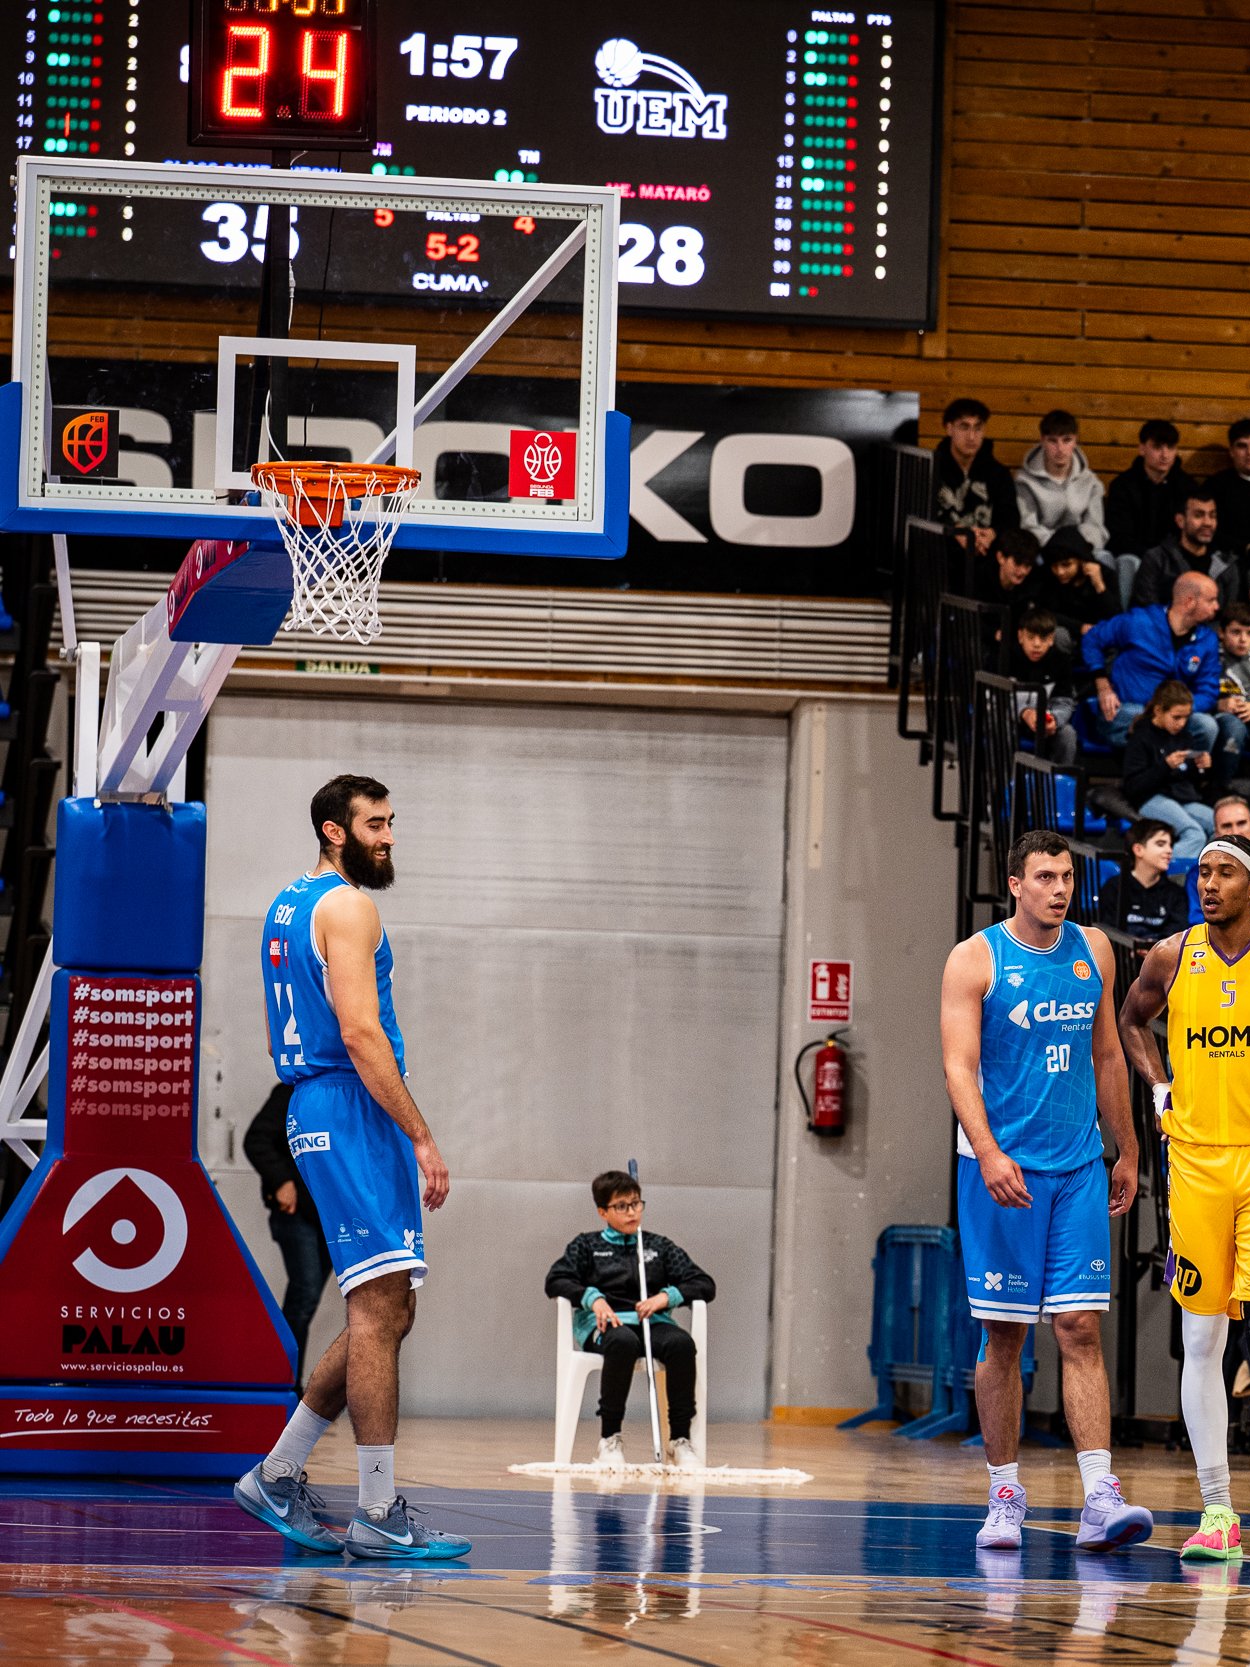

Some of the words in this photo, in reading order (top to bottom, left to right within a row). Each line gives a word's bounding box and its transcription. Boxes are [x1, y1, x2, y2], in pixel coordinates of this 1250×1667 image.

[26, 8, 37, 22] 4
[128, 13, 139, 28] 2
[126, 56, 138, 70] 2
[399, 32, 518, 80] 1:57
[786, 49, 797, 63] 2
[18, 72, 35, 86] 10
[126, 76, 138, 91] 2
[222, 24, 349, 120] 24
[16, 94, 33, 108] 11
[16, 114, 34, 128] 14
[406, 104, 490, 126] PERIODO
[492, 110, 508, 126] 2
[594, 88, 728, 140] UEM
[878, 117, 891, 132] 7
[16, 136, 34, 150] 17
[638, 184, 711, 202] MATARÓ
[200, 202, 300, 263] 35
[513, 216, 536, 235] 4
[425, 232, 480, 262] 5-2
[618, 222, 706, 286] 28
[529, 488, 554, 498] FEB
[305, 660, 372, 675] SALIDA
[73, 983, 194, 1007] #somsport
[1220, 980, 1237, 1009] 5
[72, 1006, 193, 1030] #somsport
[1033, 1000, 1095, 1022] Class
[1062, 1022, 1080, 1032] Rent
[72, 1029, 192, 1052] #somsport
[71, 1052, 192, 1076] #somsport
[1045, 1044, 1070, 1073] 20
[1208, 1050, 1246, 1058] RENTALS
[70, 1075, 191, 1098] #somsport
[70, 1098, 190, 1121] #somsport
[1008, 1280, 1028, 1288] Feeling
[60, 1306, 186, 1320] SERVICIOS
[62, 1324, 186, 1356] PALAU
[60, 1360, 184, 1373] www.serviciospalau.es
[14, 1408, 54, 1423] Todo
[62, 1408, 78, 1426] lo
[86, 1410, 117, 1426] que
[125, 1411, 213, 1426] necesitas
